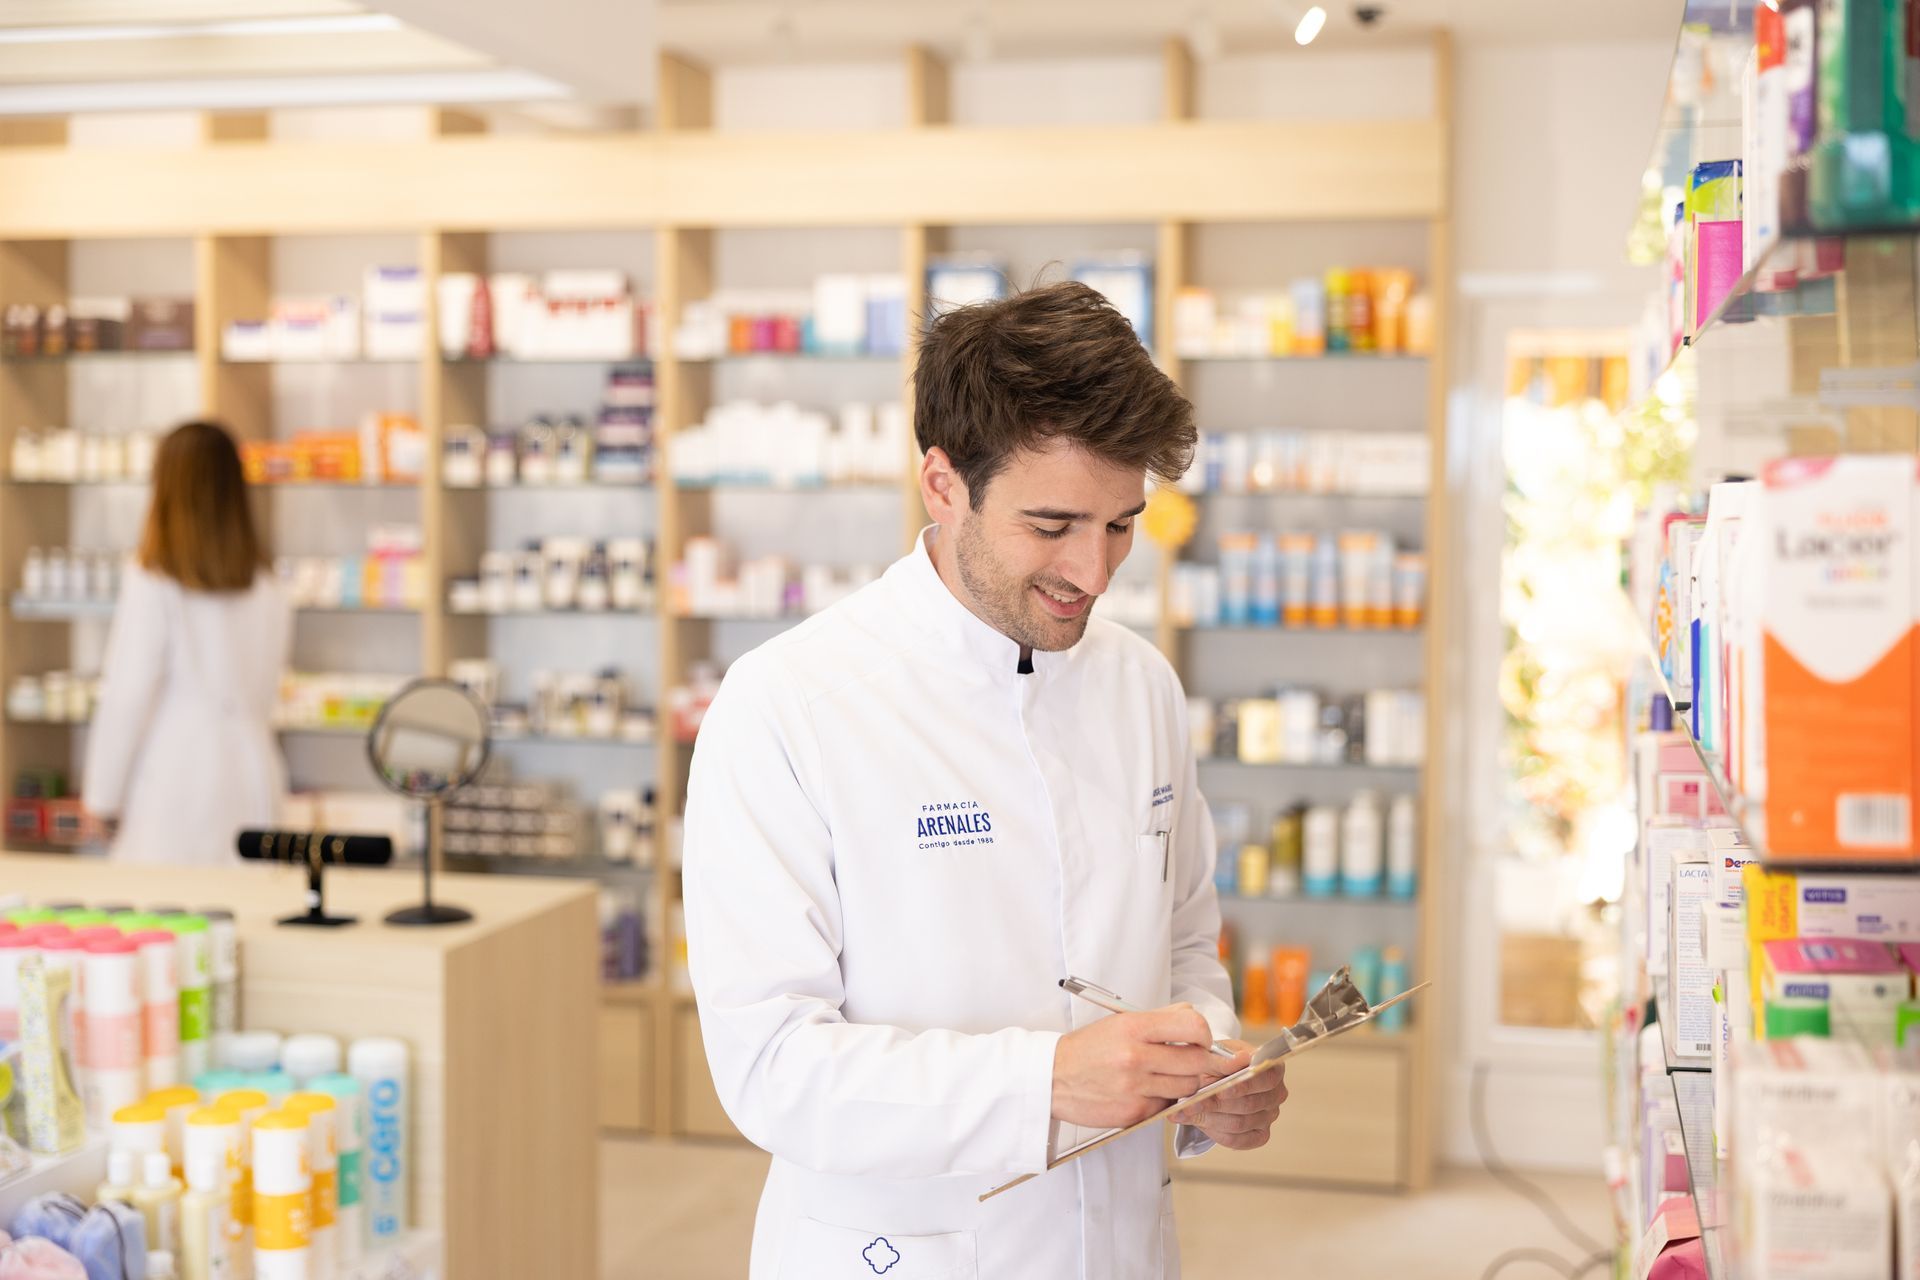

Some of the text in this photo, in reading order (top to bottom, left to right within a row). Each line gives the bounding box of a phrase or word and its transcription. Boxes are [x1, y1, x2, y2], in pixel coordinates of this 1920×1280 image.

[922, 801, 979, 812] FARMACIA
[917, 812, 992, 838] ARENALES
[918, 841, 950, 850] Contigo
[953, 838, 975, 847] desde
